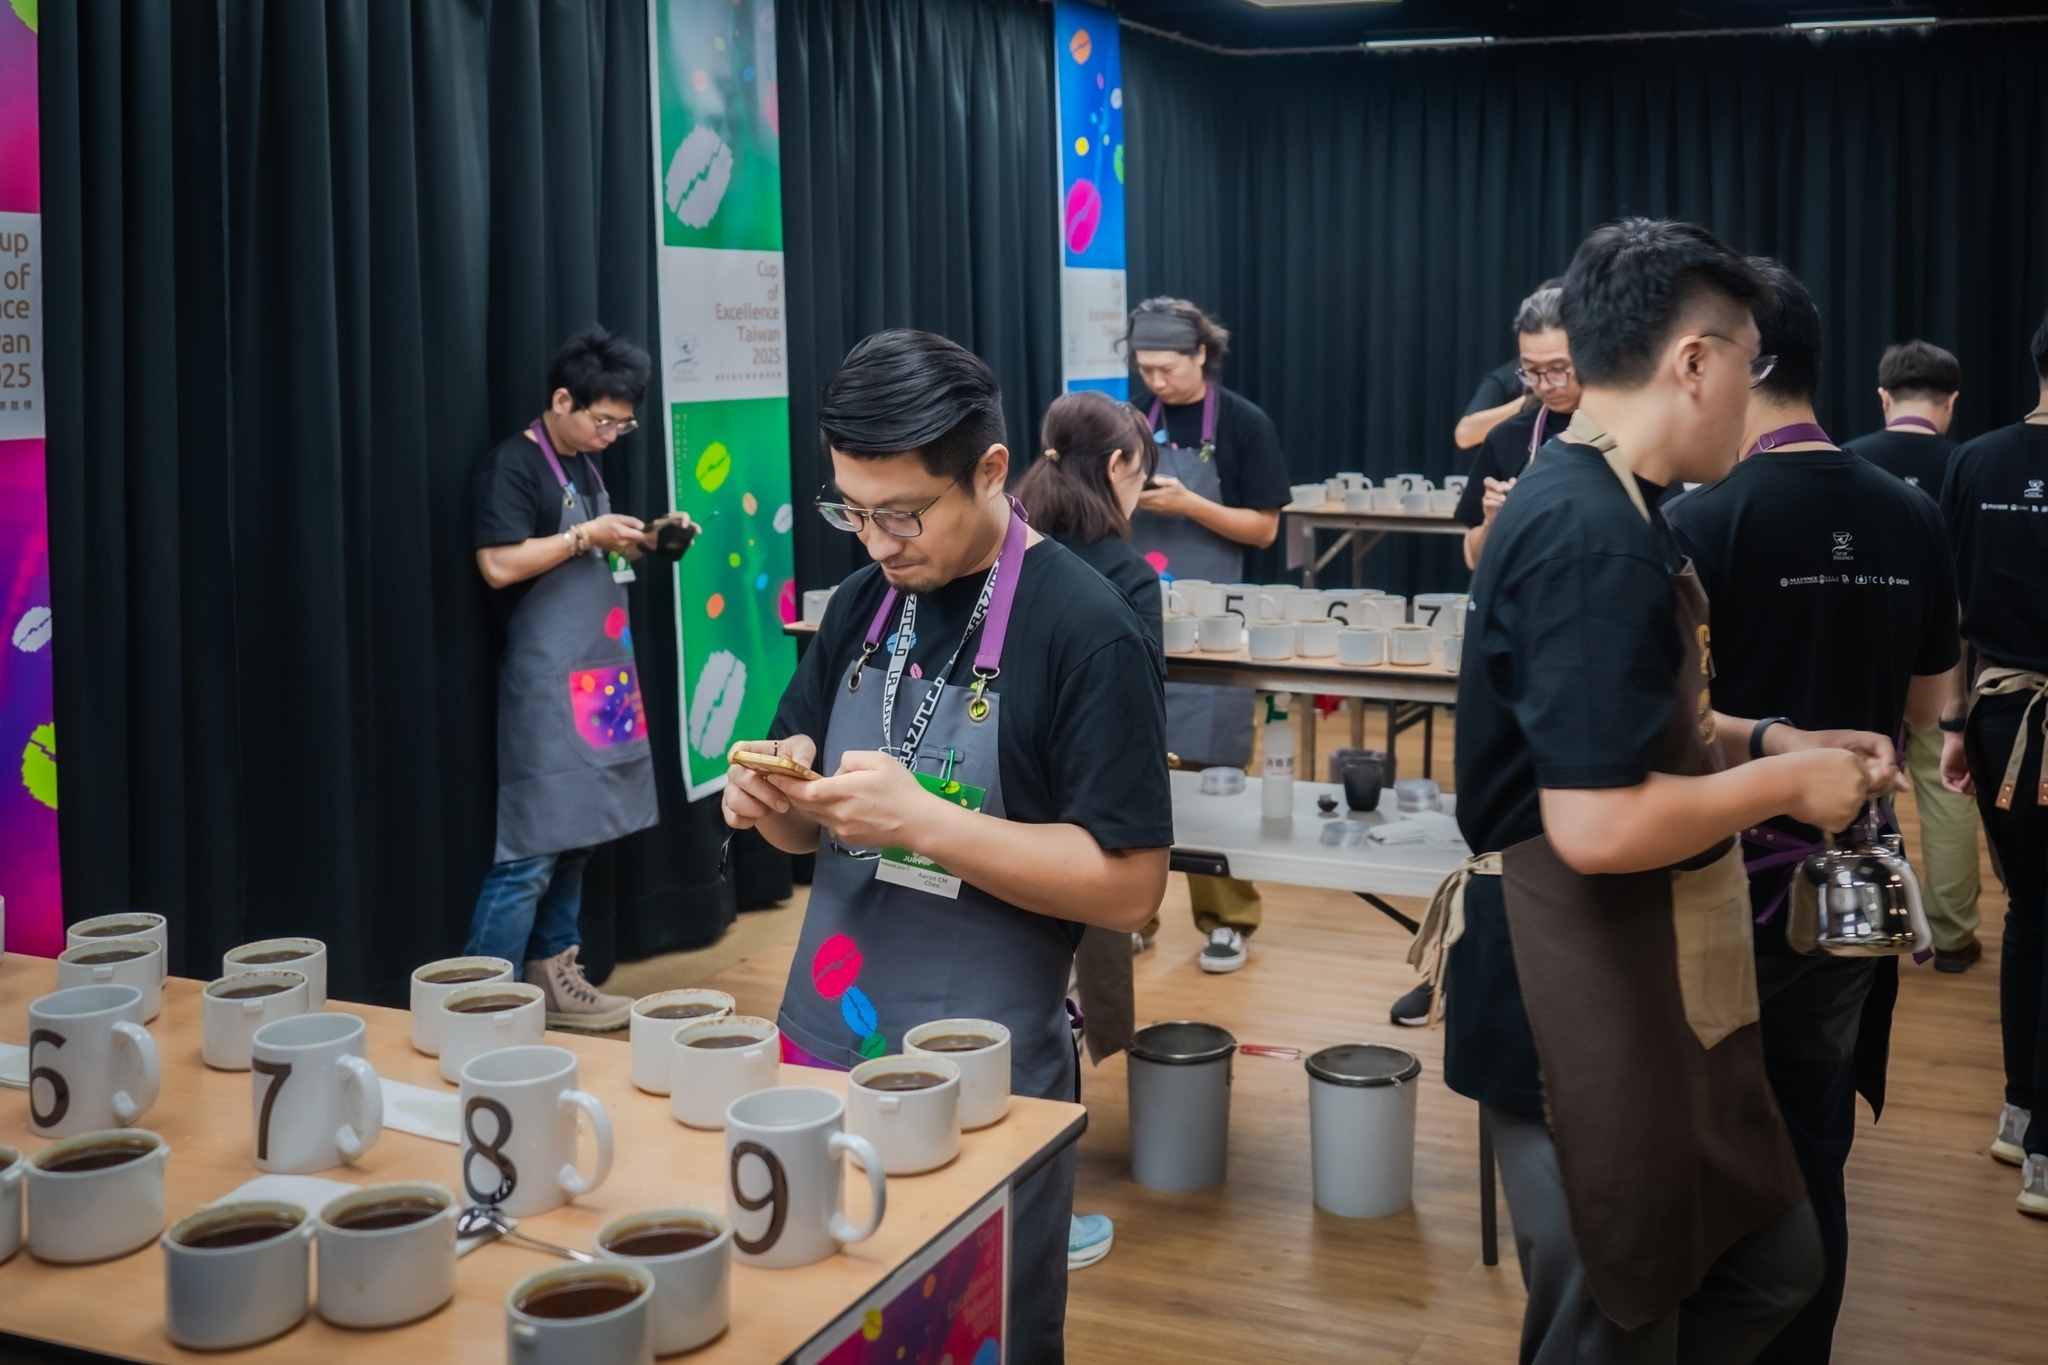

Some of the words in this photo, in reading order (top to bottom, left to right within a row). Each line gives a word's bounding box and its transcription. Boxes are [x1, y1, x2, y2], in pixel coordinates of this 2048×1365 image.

[4, 263, 31, 290] of
[757, 260, 779, 279] Cup
[767, 284, 780, 301] of
[0, 300, 30, 319] ce
[716, 303, 780, 320] Excellence
[737, 325, 781, 342] Taiwan
[0, 334, 31, 353] an
[752, 347, 781, 365] 2025
[0, 363, 32, 388] 25
[1226, 594, 1246, 628] 5
[1327, 601, 1349, 626] 6
[1418, 604, 1442, 627] 7
[902, 855, 922, 865] JURY
[918, 872, 937, 881] Aaron
[924, 880, 940, 889] Chen
[29, 1028, 70, 1128] 6
[252, 1056, 292, 1161] 7
[463, 1096, 517, 1205] 8
[731, 1140, 788, 1255] 9
